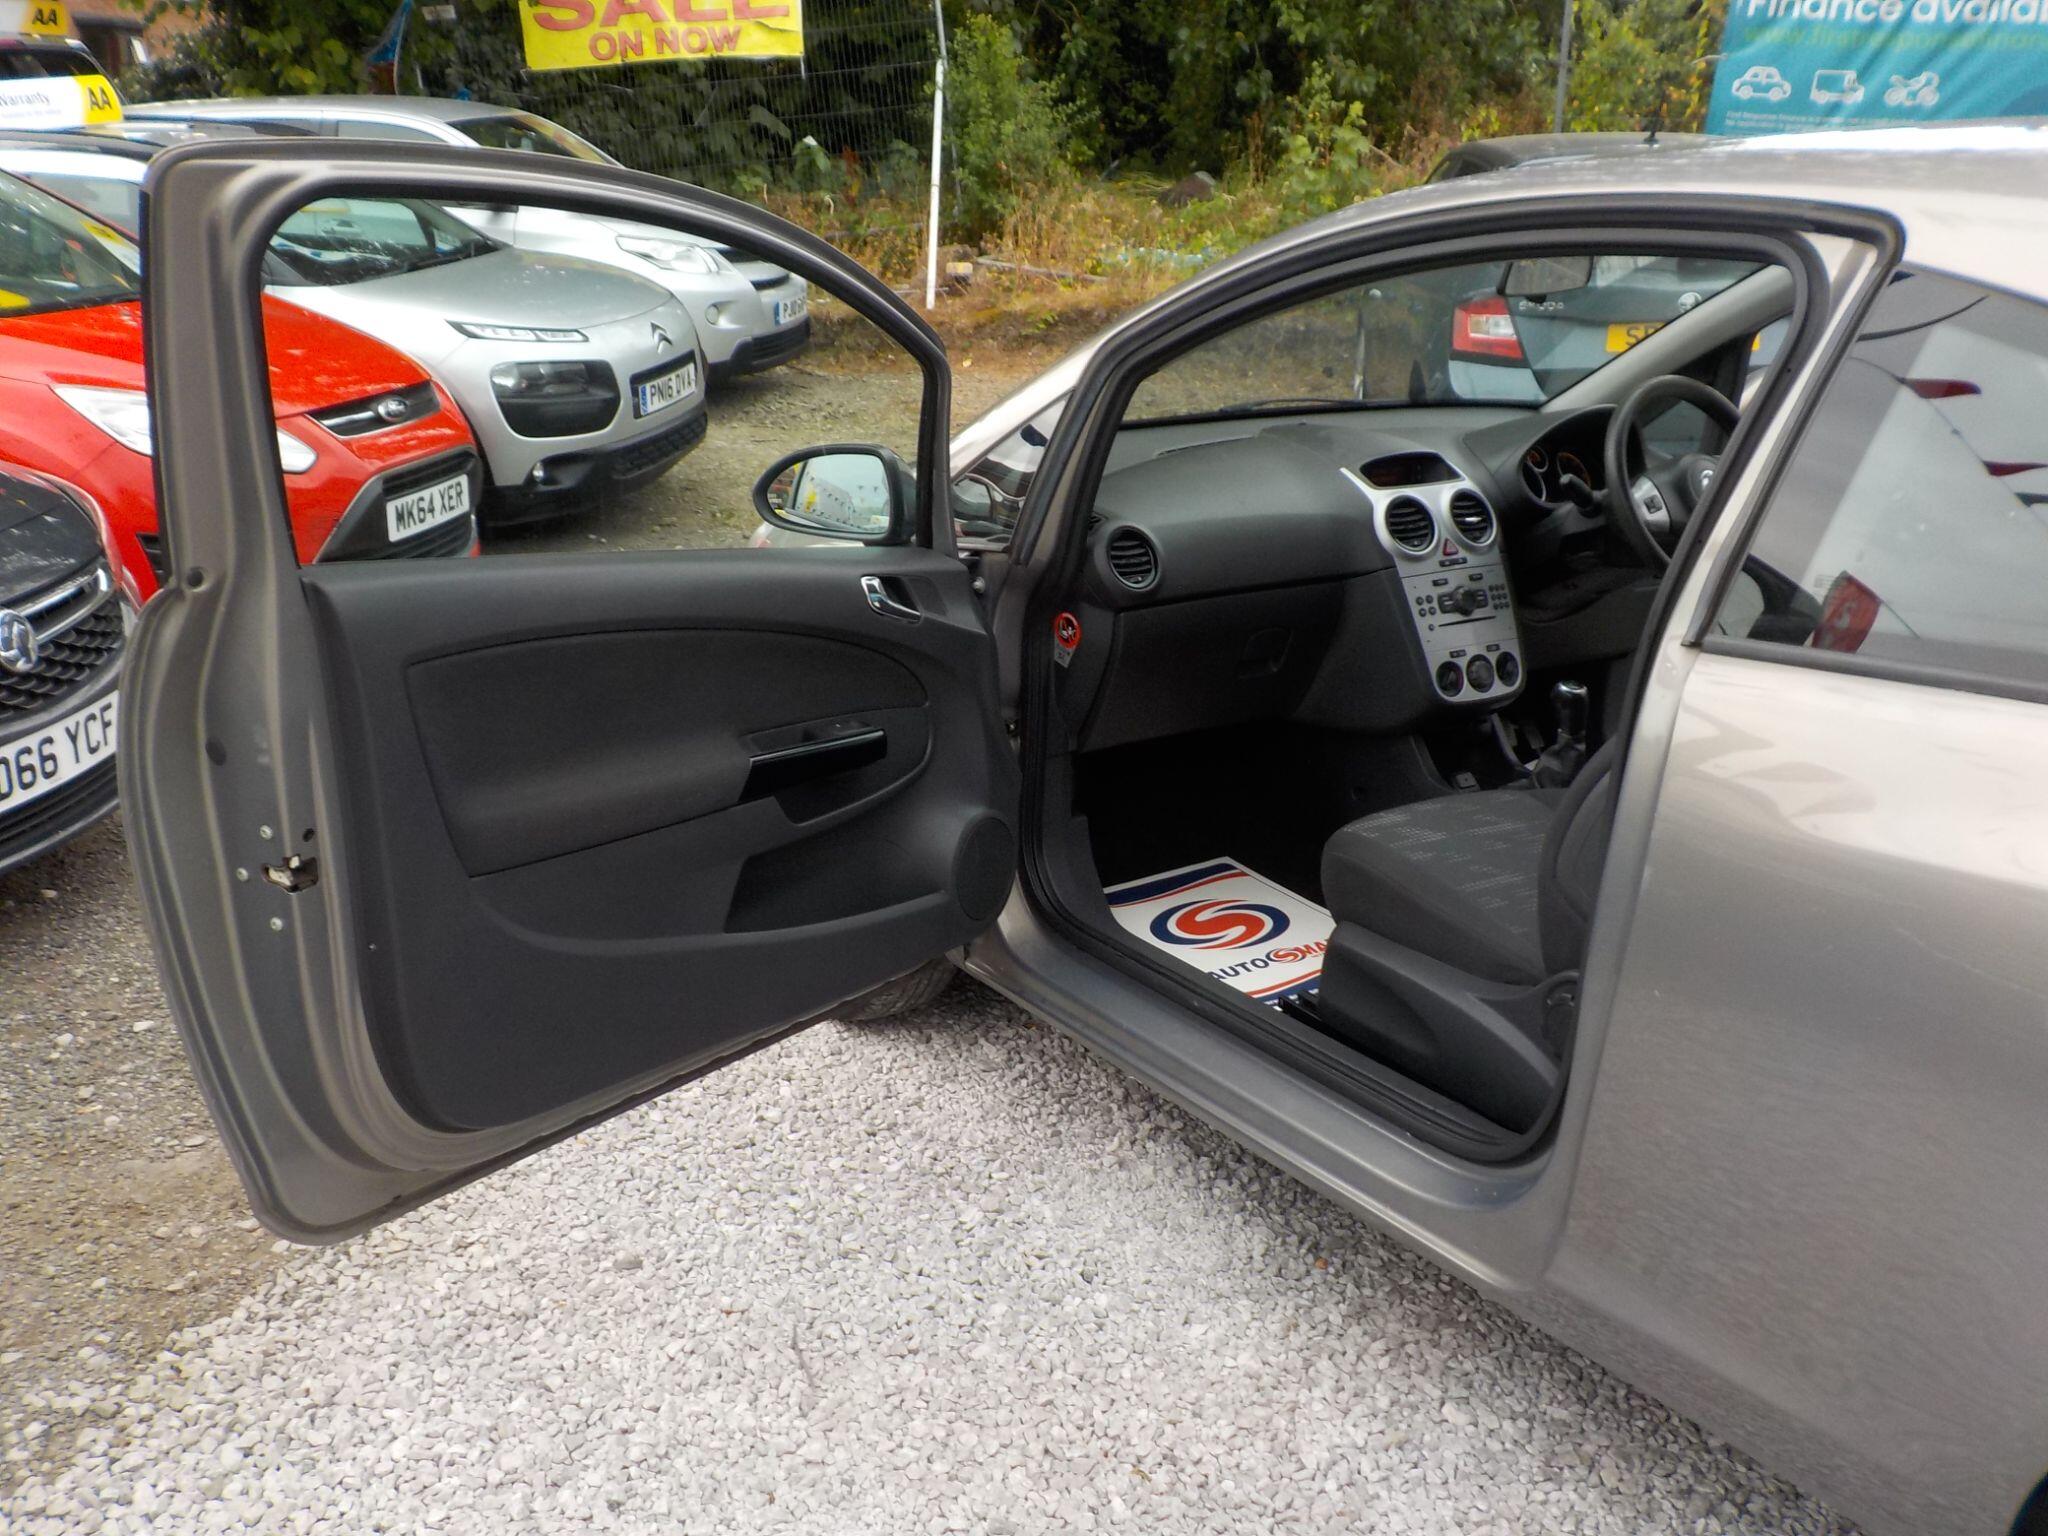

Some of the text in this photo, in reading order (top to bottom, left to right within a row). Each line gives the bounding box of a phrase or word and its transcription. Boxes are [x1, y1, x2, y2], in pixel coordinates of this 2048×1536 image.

[32, 8, 58, 26] AA
[1911, 0, 2048, 23] availa
[589, 25, 742, 61] ON NOW
[87, 86, 112, 111] AA
[395, 481, 463, 533] MK64 XER
[65, 702, 113, 764] YCF
